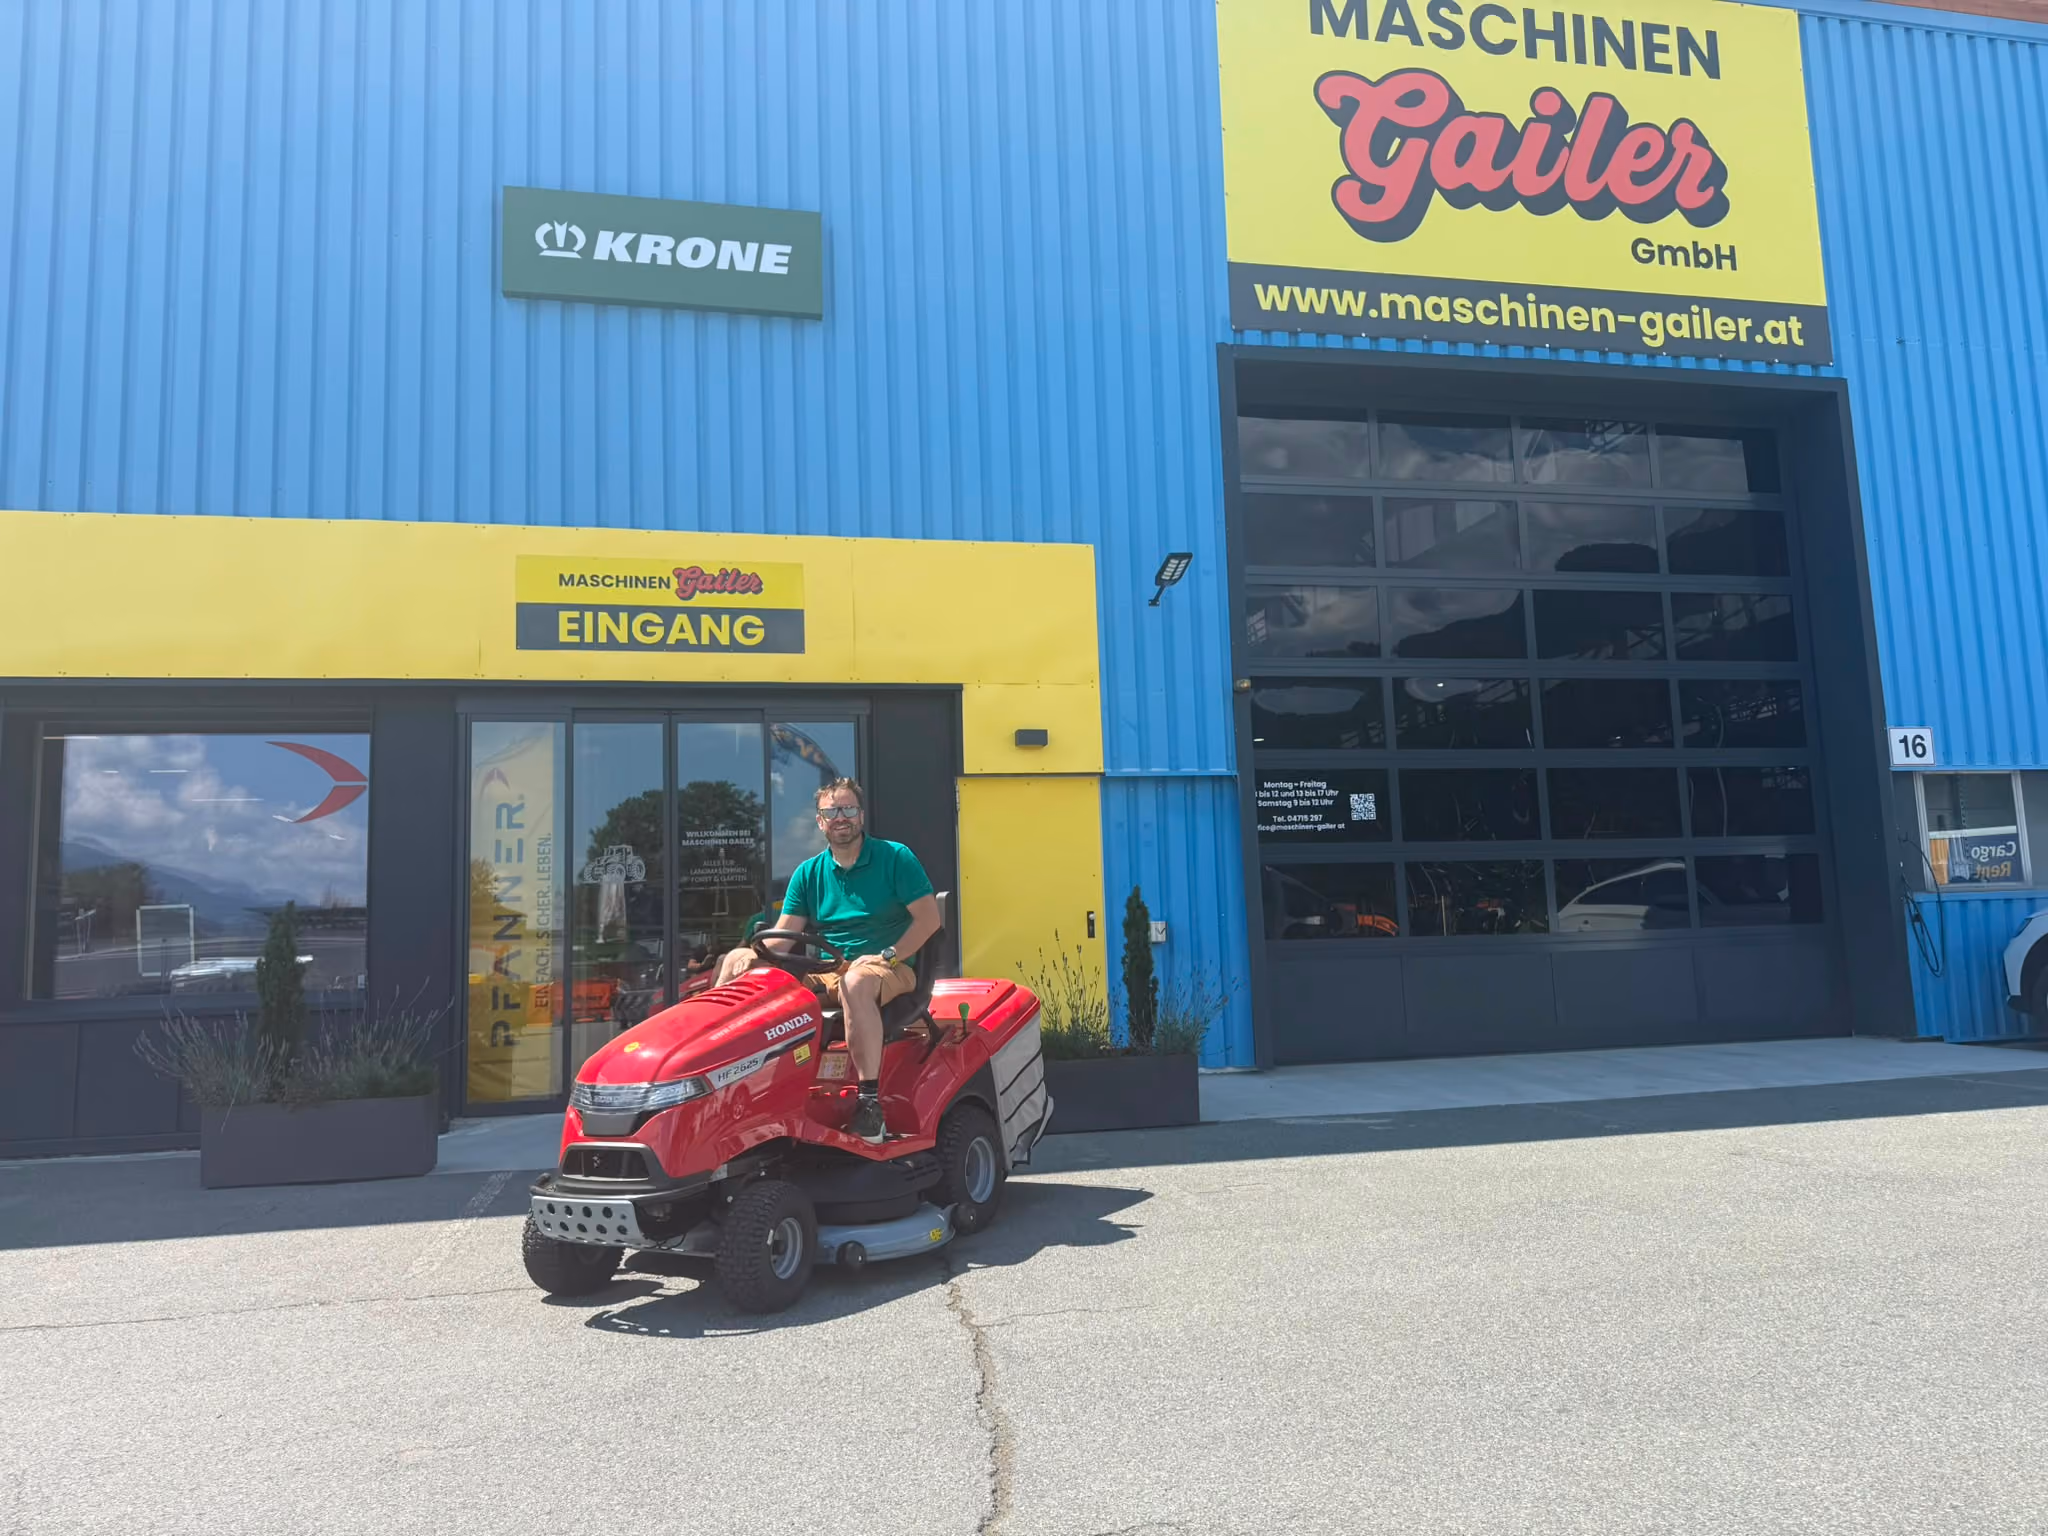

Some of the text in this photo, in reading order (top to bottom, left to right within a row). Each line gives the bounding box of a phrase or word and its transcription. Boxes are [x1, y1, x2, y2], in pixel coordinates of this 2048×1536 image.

[1309, 0, 1721, 79] MASCHINEN
[1313, 67, 1730, 242] Gailer
[593, 230, 792, 275] KRONE
[1631, 237, 1737, 271] GmbH
[1254, 282, 1804, 347] www.maschinen-gailer.at
[559, 566, 763, 601] MASCHINEN Gailer
[558, 610, 765, 646] EINGANG
[1898, 734, 1927, 759] 16
[1259, 790, 1270, 798] bis
[1304, 789, 1316, 797] bis
[1325, 789, 1339, 797] Uhr
[1263, 781, 1293, 790] Montag
[1300, 780, 1327, 790] Freitag
[1257, 799, 1292, 809] Samstag
[1299, 798, 1311, 806] bis
[1311, 798, 1319, 806] 12
[1320, 798, 1334, 806] Uhr
[1272, 815, 1286, 823] Tel.
[535, 833, 552, 882] LEBEN.
[764, 1013, 813, 1041] HONDA
[718, 1067, 732, 1083] HF
